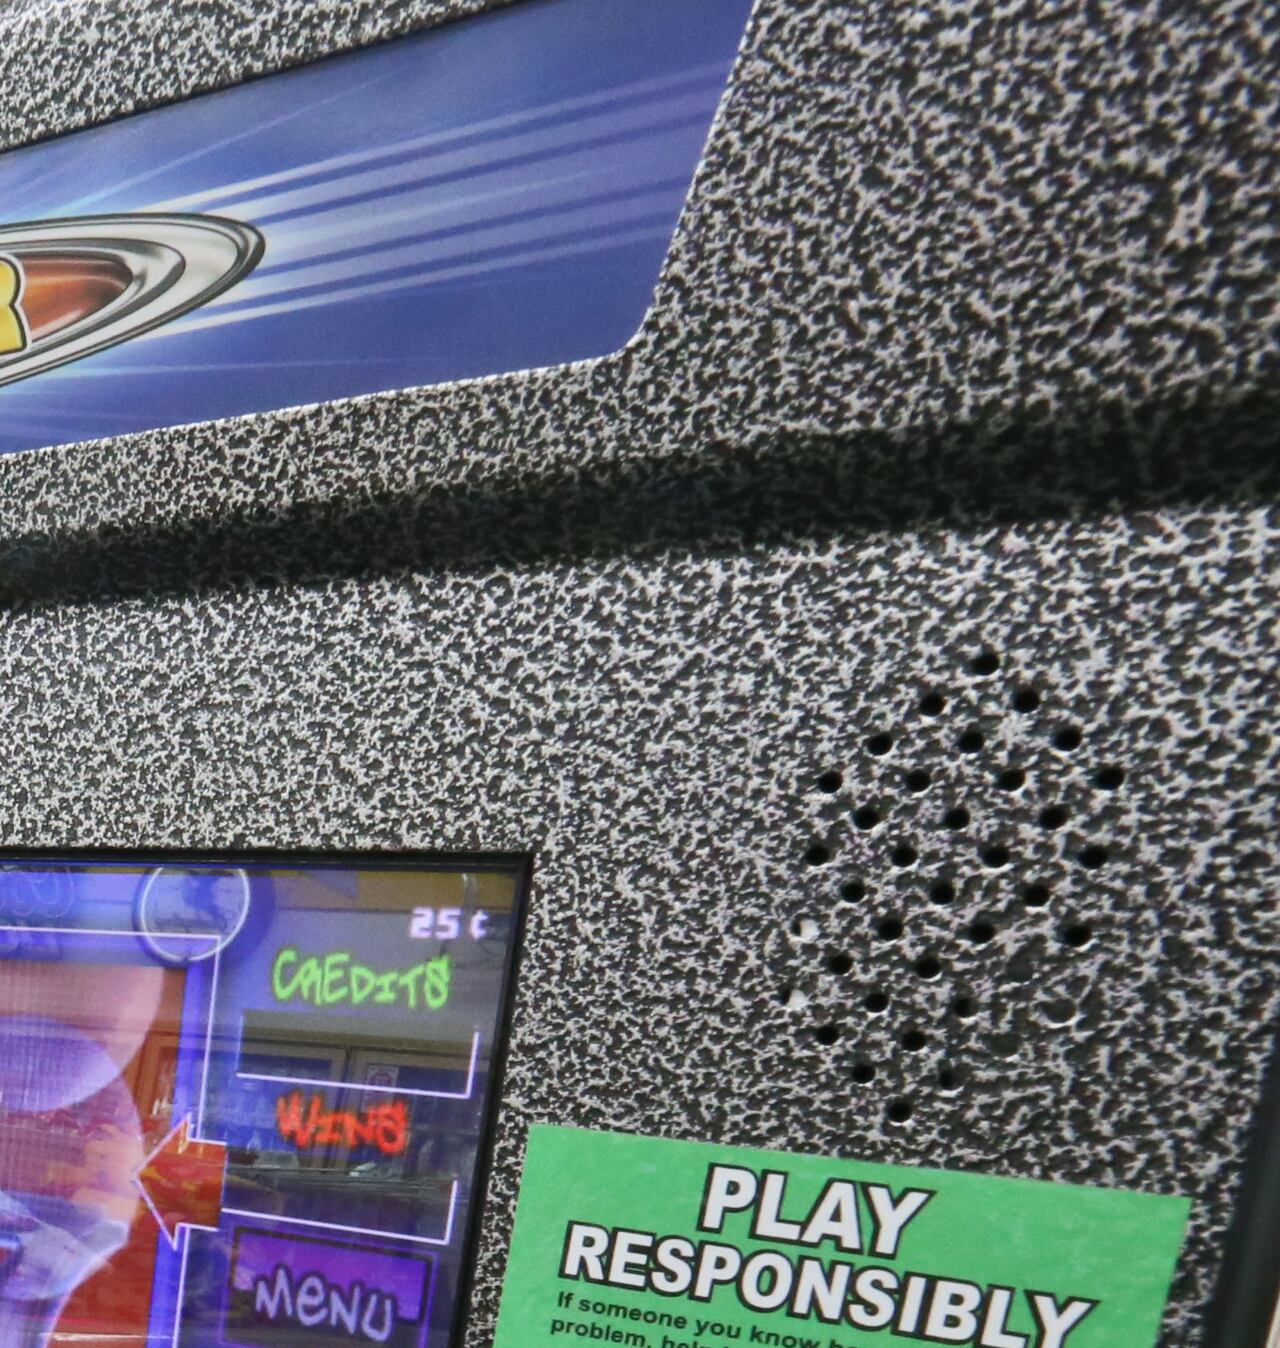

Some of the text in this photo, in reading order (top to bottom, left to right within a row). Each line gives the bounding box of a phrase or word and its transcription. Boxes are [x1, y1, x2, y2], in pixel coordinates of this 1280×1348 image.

[271, 945, 453, 1010] CREDITS
[697, 1161, 938, 1258] PLAY
[557, 1291, 574, 1308] If
[577, 1298, 689, 1330] someone
[696, 1318, 742, 1339] you
